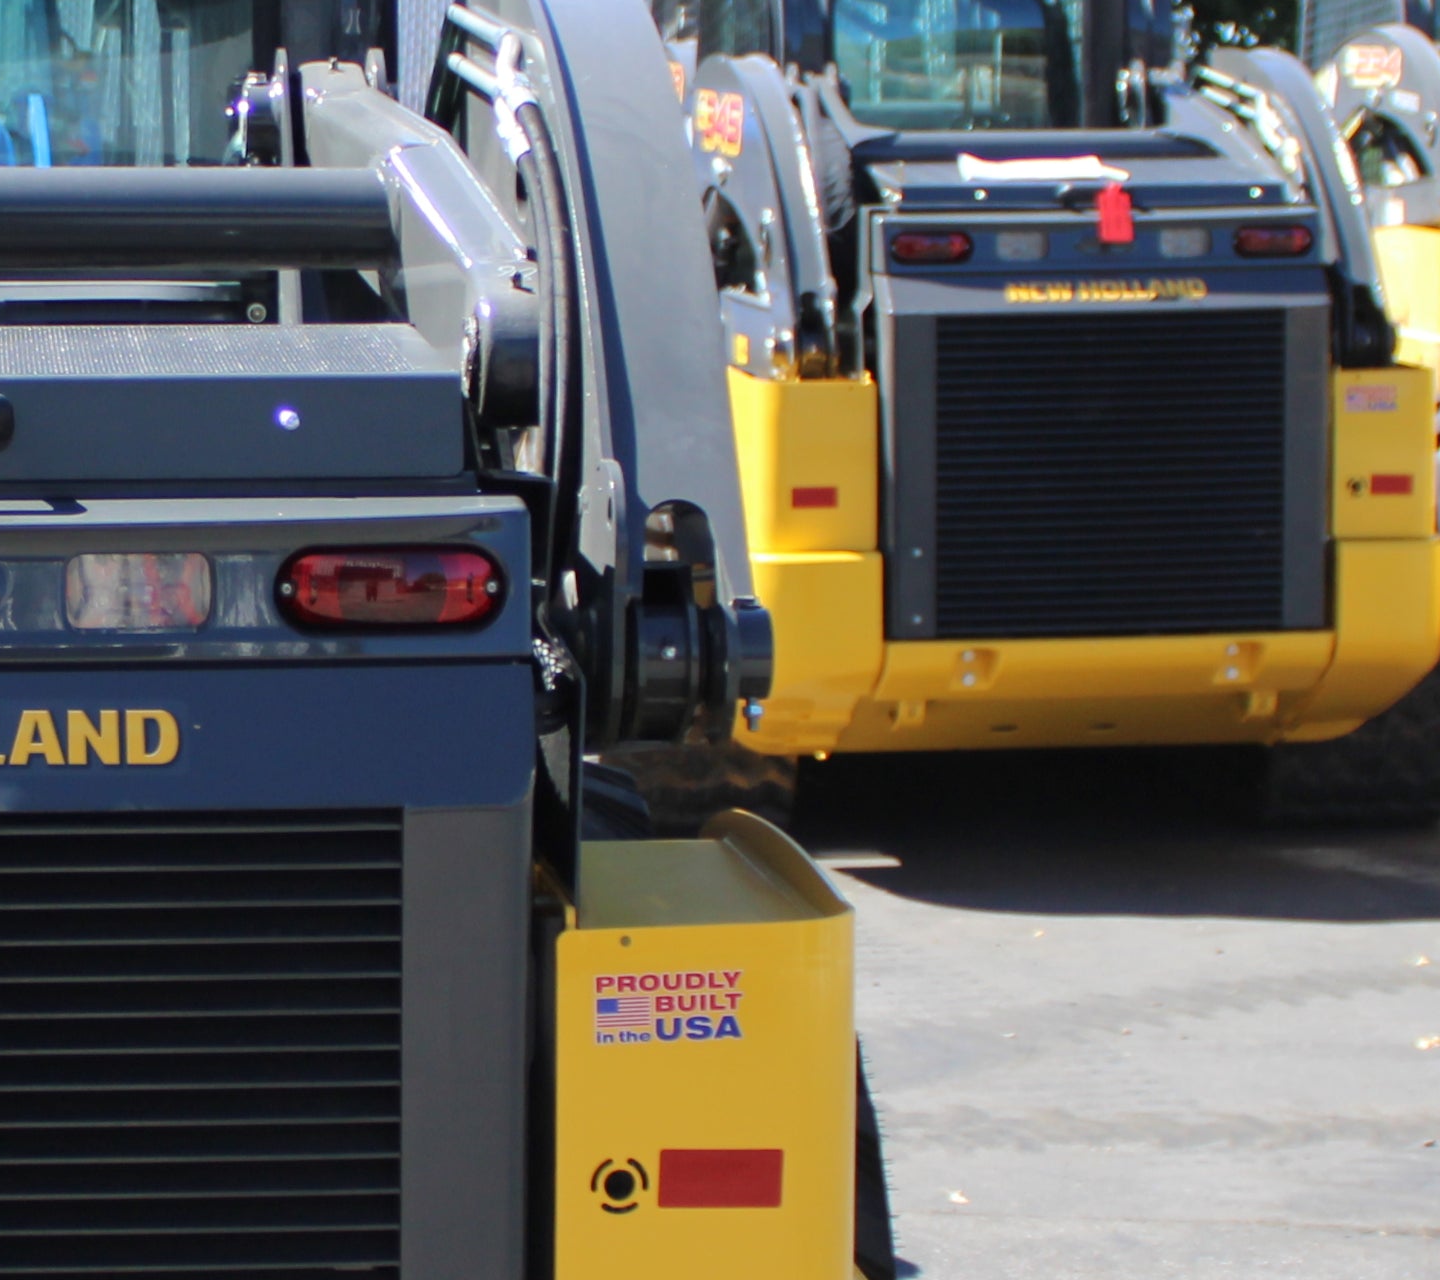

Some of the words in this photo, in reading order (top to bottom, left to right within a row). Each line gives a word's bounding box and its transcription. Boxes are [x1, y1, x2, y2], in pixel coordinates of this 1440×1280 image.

[1005, 282, 1073, 302] NEW
[1078, 277, 1208, 301] HOLLAND
[595, 971, 741, 993] PROUDLY
[655, 993, 742, 1012] BUILT
[596, 1031, 614, 1043] in
[619, 1030, 651, 1043] the
[655, 1015, 742, 1041] USA
